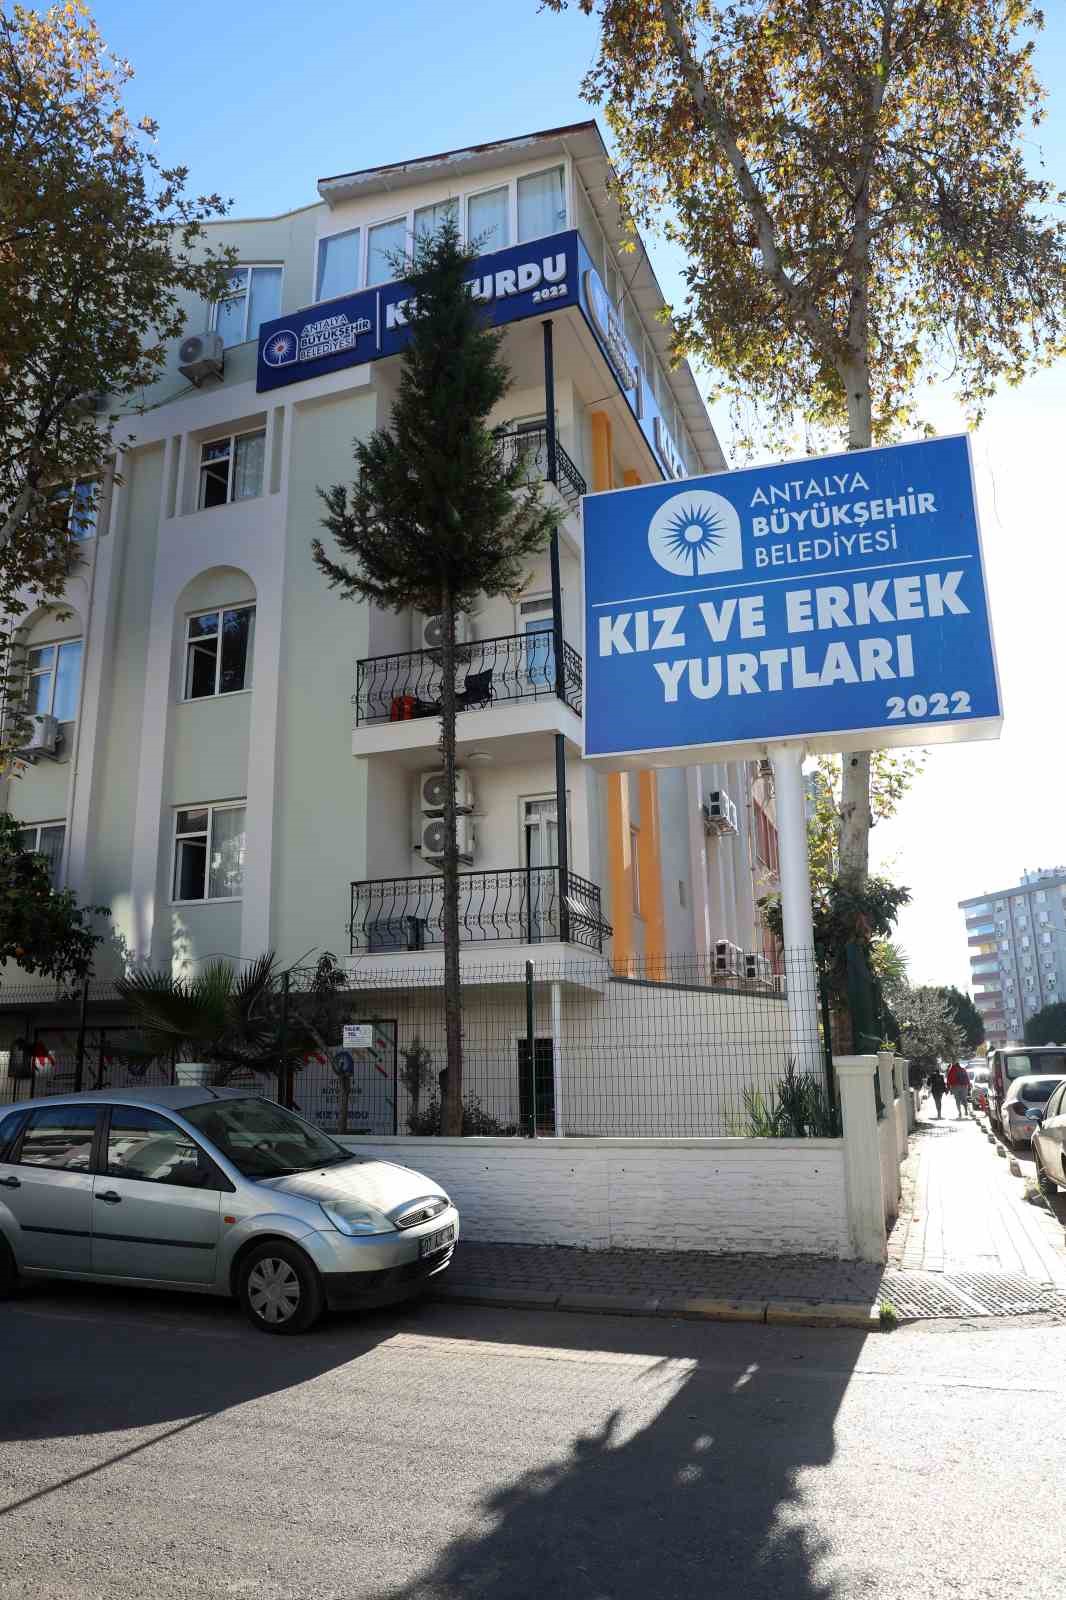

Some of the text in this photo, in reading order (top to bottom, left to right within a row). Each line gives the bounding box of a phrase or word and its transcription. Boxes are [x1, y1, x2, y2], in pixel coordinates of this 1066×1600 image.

[531, 284, 568, 304] 2022
[301, 313, 348, 336] ANTALYA
[750, 472, 869, 507] ANTALYA
[752, 487, 937, 537] BÜYÜKŞEHİR
[755, 525, 898, 568] BELEDİYESİ
[598, 570, 971, 657] KIZ VE ERKEK
[653, 634, 914, 703] YURTLARI
[885, 690, 972, 719] 2022
